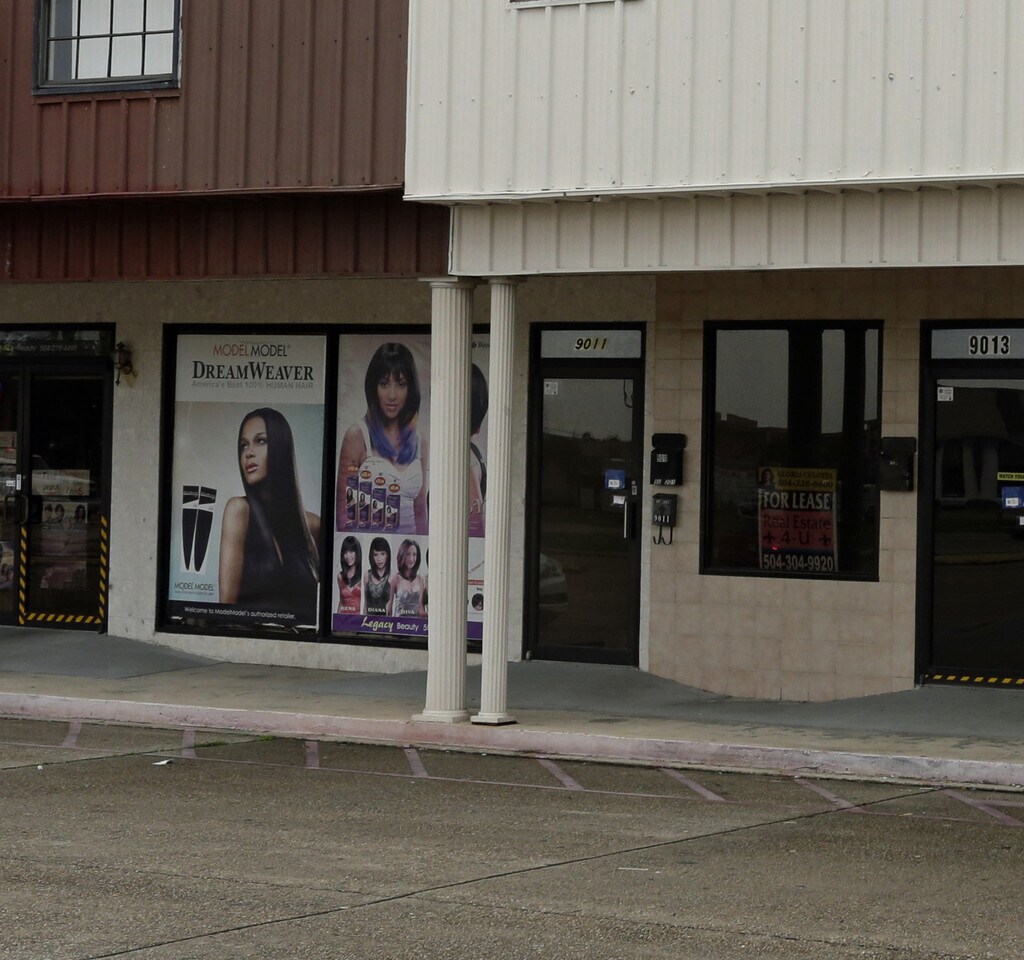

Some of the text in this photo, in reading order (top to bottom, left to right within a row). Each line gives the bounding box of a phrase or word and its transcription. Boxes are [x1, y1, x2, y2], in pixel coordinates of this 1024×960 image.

[213, 344, 249, 356] MODEL
[575, 338, 607, 350] 9011
[969, 335, 1010, 355] 9013
[266, 381, 294, 390] HUMAN
[295, 382, 314, 390] HAIR
[763, 491, 831, 510] FOR LEASE
[653, 514, 670, 523] 9011
[763, 513, 831, 530] Real Estate
[780, 530, 810, 545] 4-U
[763, 553, 833, 571] 504-304-9920
[174, 582, 193, 590] MODEL
[184, 606, 207, 614] Welcome
[214, 608, 250, 617] ModelModel's
[250, 610, 277, 618] authorized
[361, 616, 394, 632] Legacy
[397, 622, 419, 631] Beauty
